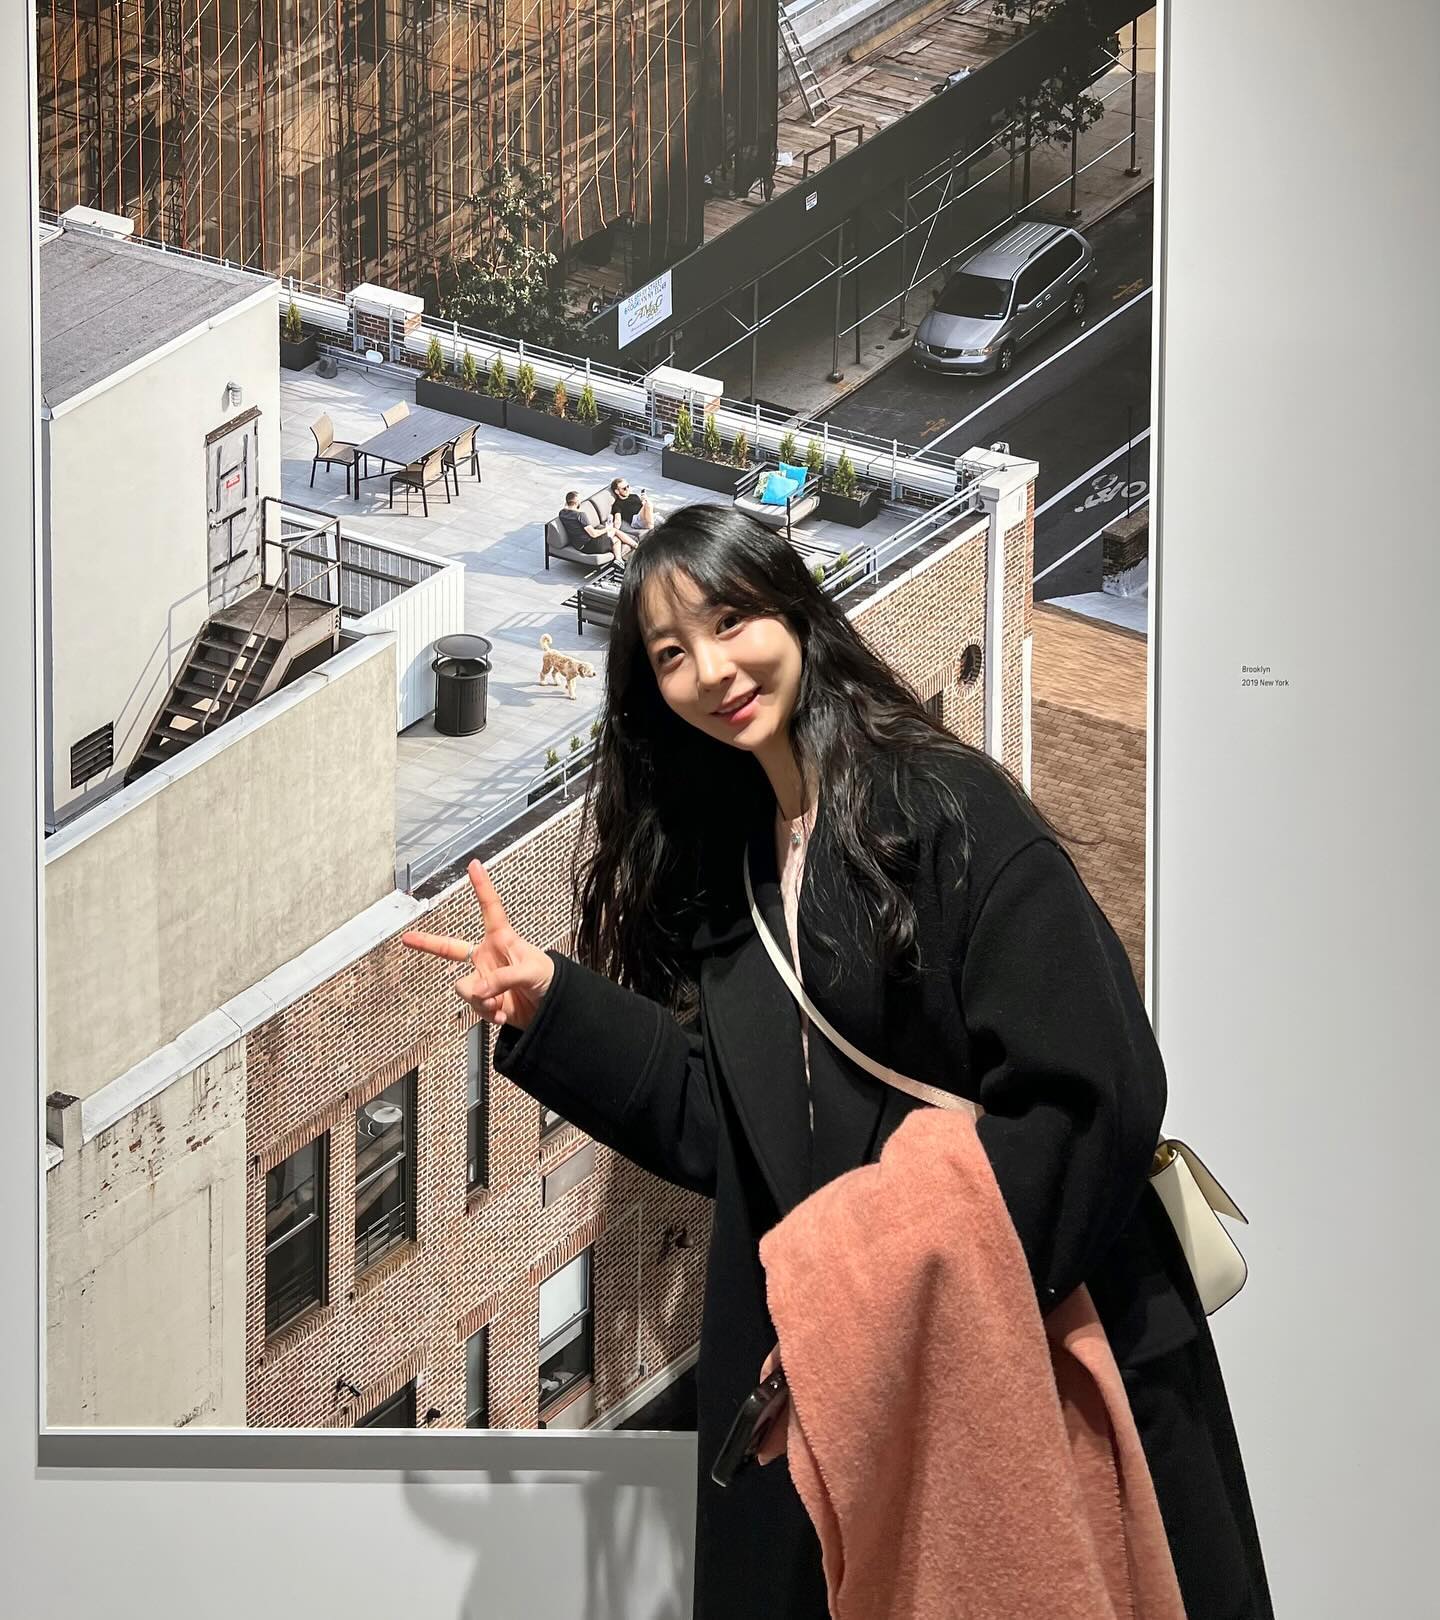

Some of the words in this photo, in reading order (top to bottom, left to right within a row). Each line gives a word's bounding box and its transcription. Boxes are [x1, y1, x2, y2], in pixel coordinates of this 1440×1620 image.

[1241, 665, 1271, 674] Brooklyn
[1241, 678, 1259, 687] 2019
[1260, 678, 1274, 687] New
[1274, 679, 1290, 687] York
